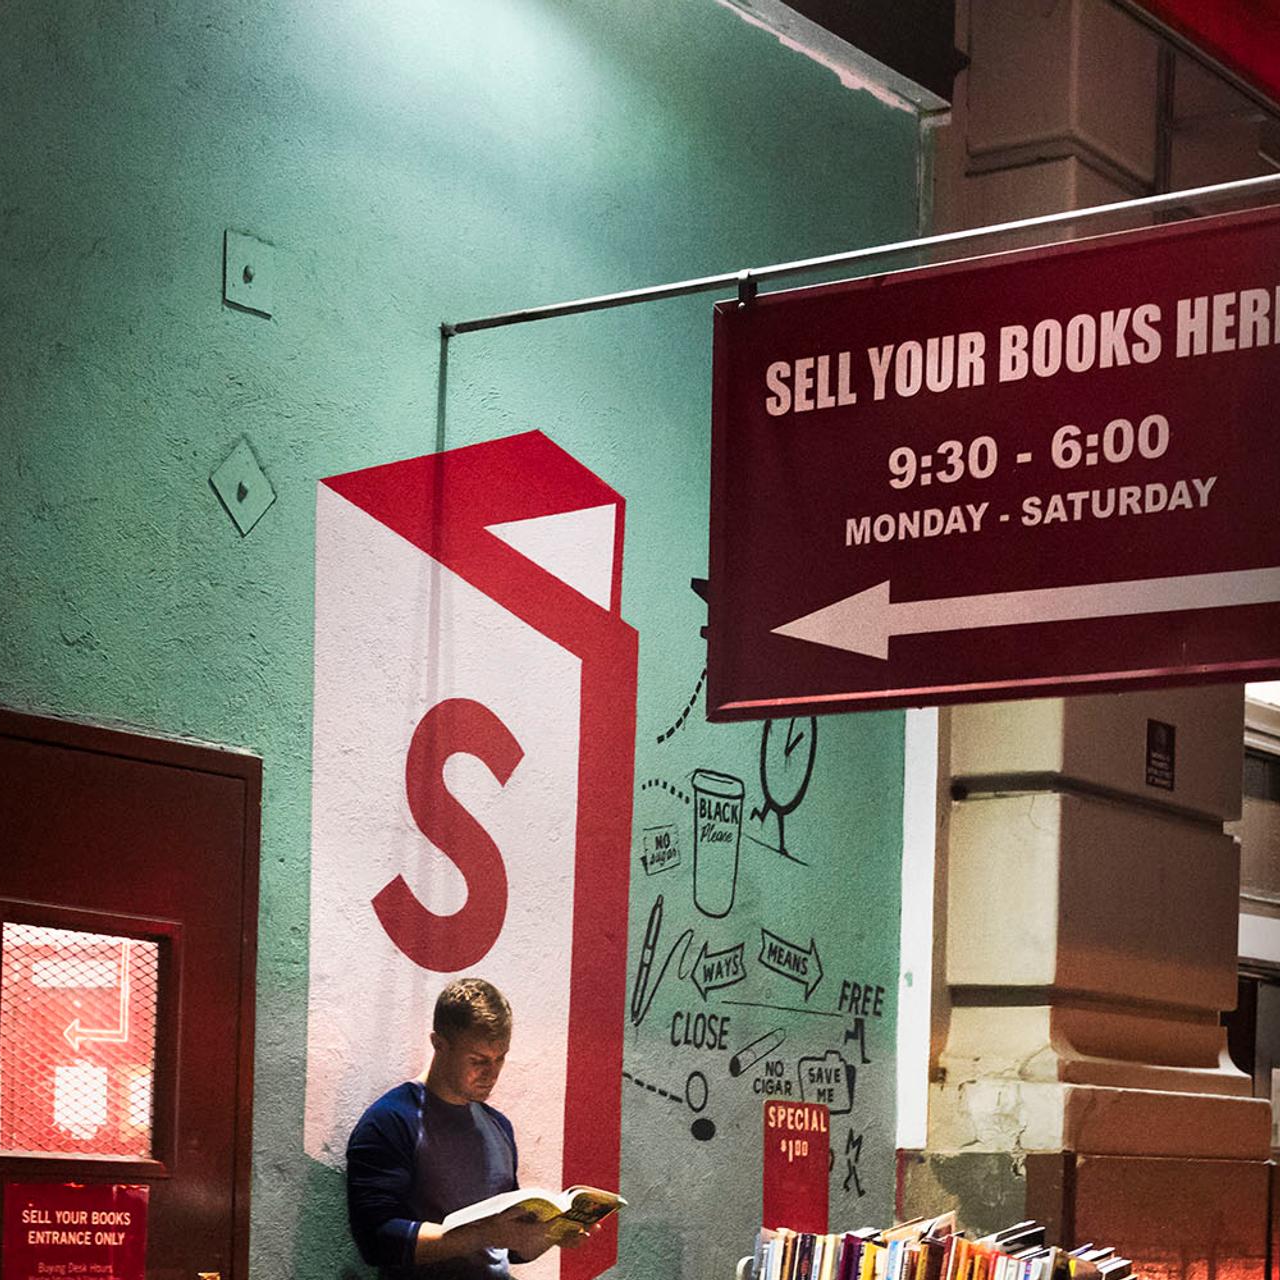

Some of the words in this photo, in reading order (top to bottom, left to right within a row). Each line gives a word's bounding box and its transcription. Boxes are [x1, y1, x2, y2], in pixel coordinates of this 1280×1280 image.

[766, 351, 857, 417] SELL
[867, 331, 986, 401] YOUR
[999, 304, 1162, 383] BOOKS
[888, 436, 998, 490] 9:30
[1051, 414, 1170, 470] 6:00
[845, 502, 989, 546] MONDAY
[1021, 476, 1218, 527] SATURDAY
[699, 798, 740, 825] BLACK
[371, 697, 526, 973] S
[655, 832, 671, 850] NO
[700, 822, 733, 843] Please
[702, 953, 739, 983] WAYS
[767, 942, 809, 976] MEANS
[837, 979, 885, 1018] FREE
[671, 1010, 731, 1050] CLOSE
[765, 1060, 785, 1078] NO
[808, 1067, 841, 1084] SAVE
[752, 1078, 793, 1096] CIGAR
[816, 1088, 834, 1103] ME
[768, 1105, 827, 1133] SPECIAL
[22, 1209, 52, 1224] SELL
[55, 1210, 88, 1225] YOUR
[91, 1211, 131, 1226] BOOKS
[28, 1230, 92, 1245] ENTRANCE
[94, 1231, 125, 1246] ONLY
